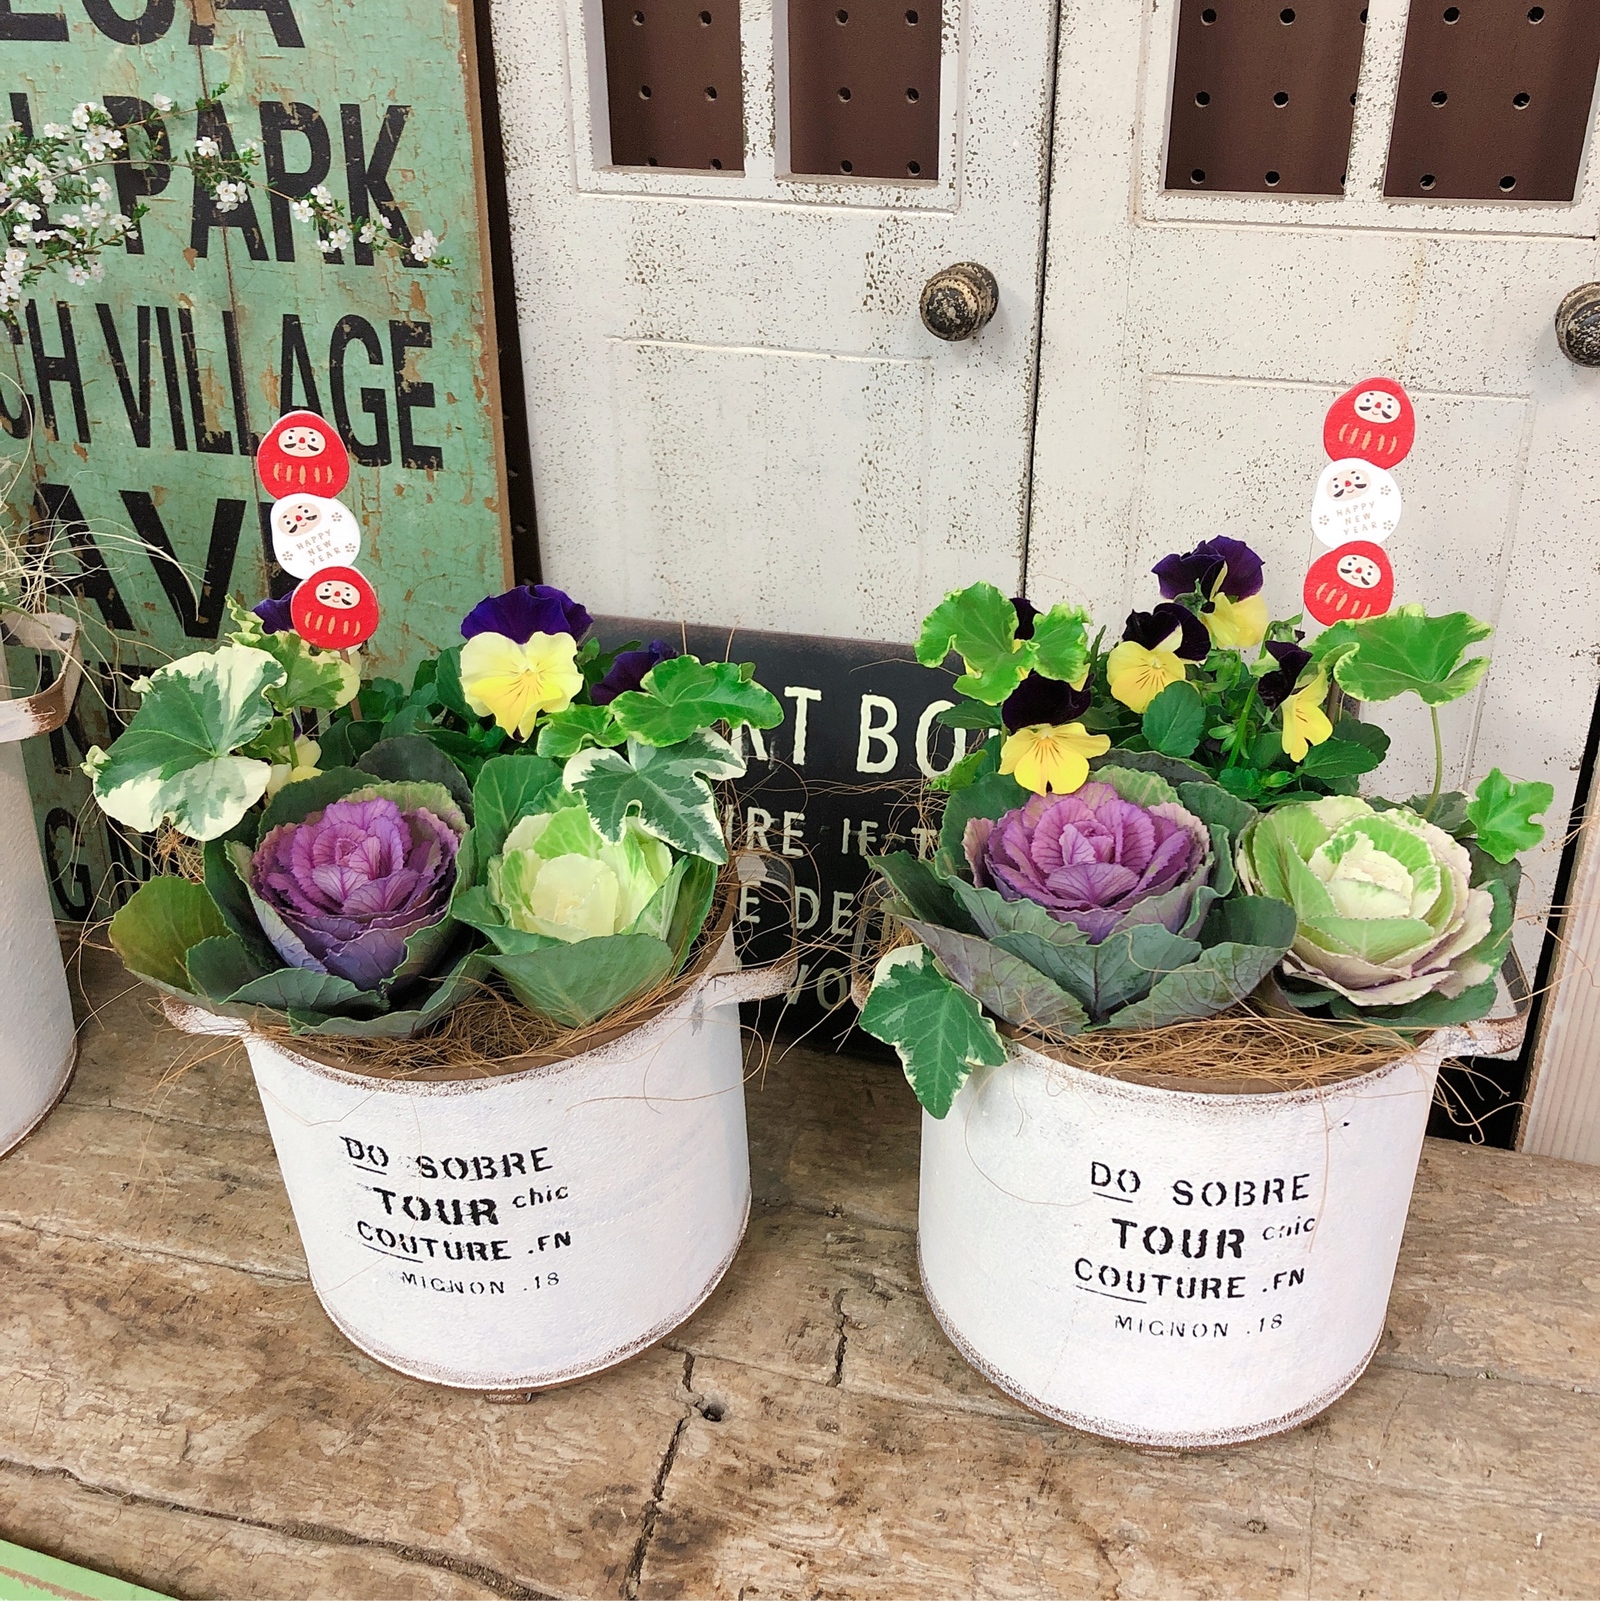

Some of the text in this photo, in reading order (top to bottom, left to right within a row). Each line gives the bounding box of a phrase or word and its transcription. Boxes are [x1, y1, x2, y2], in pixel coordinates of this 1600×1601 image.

[103, 95, 427, 268] PARK
[95, 303, 443, 470] VILLAGE
[1336, 501, 1375, 516] HAPPY
[1345, 512, 1371, 525] NEW
[296, 529, 330, 550] HAPPY
[1343, 521, 1377, 535] YEAR
[307, 540, 331, 556] NEW
[310, 547, 341, 565] YEAR
[339, 1136, 553, 1181] DO SOBRE
[1091, 1161, 1310, 1207] DO SOBRE
[373, 1185, 569, 1226] TOUR chic
[357, 1220, 572, 1261] COUTURE .FN
[1111, 1218, 1245, 1259] TOUR
[401, 1271, 560, 1294] MIGNON .18
[1074, 1257, 1305, 1300] COUTURE .FN
[1114, 1313, 1284, 1338] MIGNON .18
